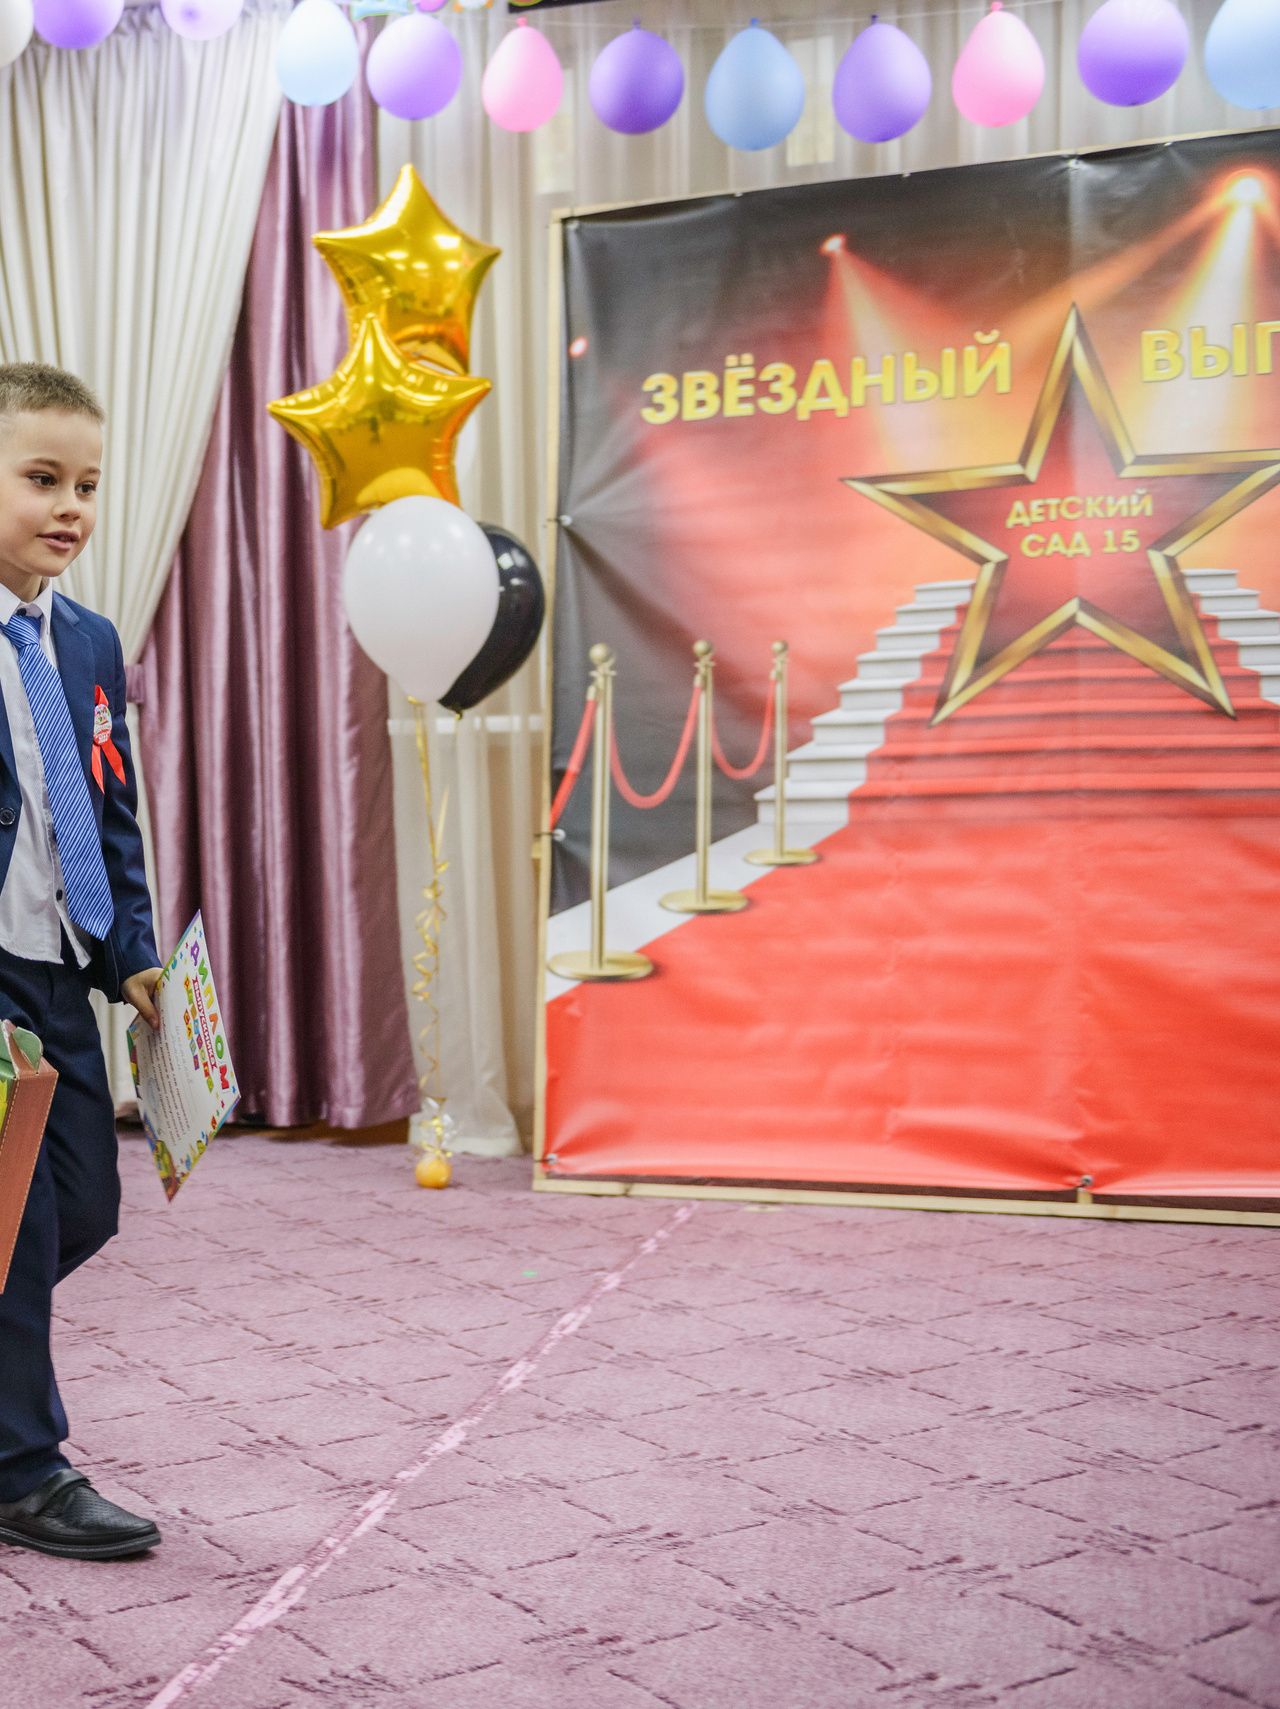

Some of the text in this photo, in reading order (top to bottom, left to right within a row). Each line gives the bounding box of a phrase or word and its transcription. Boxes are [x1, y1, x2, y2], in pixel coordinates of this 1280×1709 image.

[640, 329, 1012, 425] ЗВЁЗДНЫЙ
[1005, 488, 1154, 528] ДЕТСКИЙ
[1020, 528, 1141, 558] САД 15
[190, 940, 230, 1091] ДИПЛОМ
